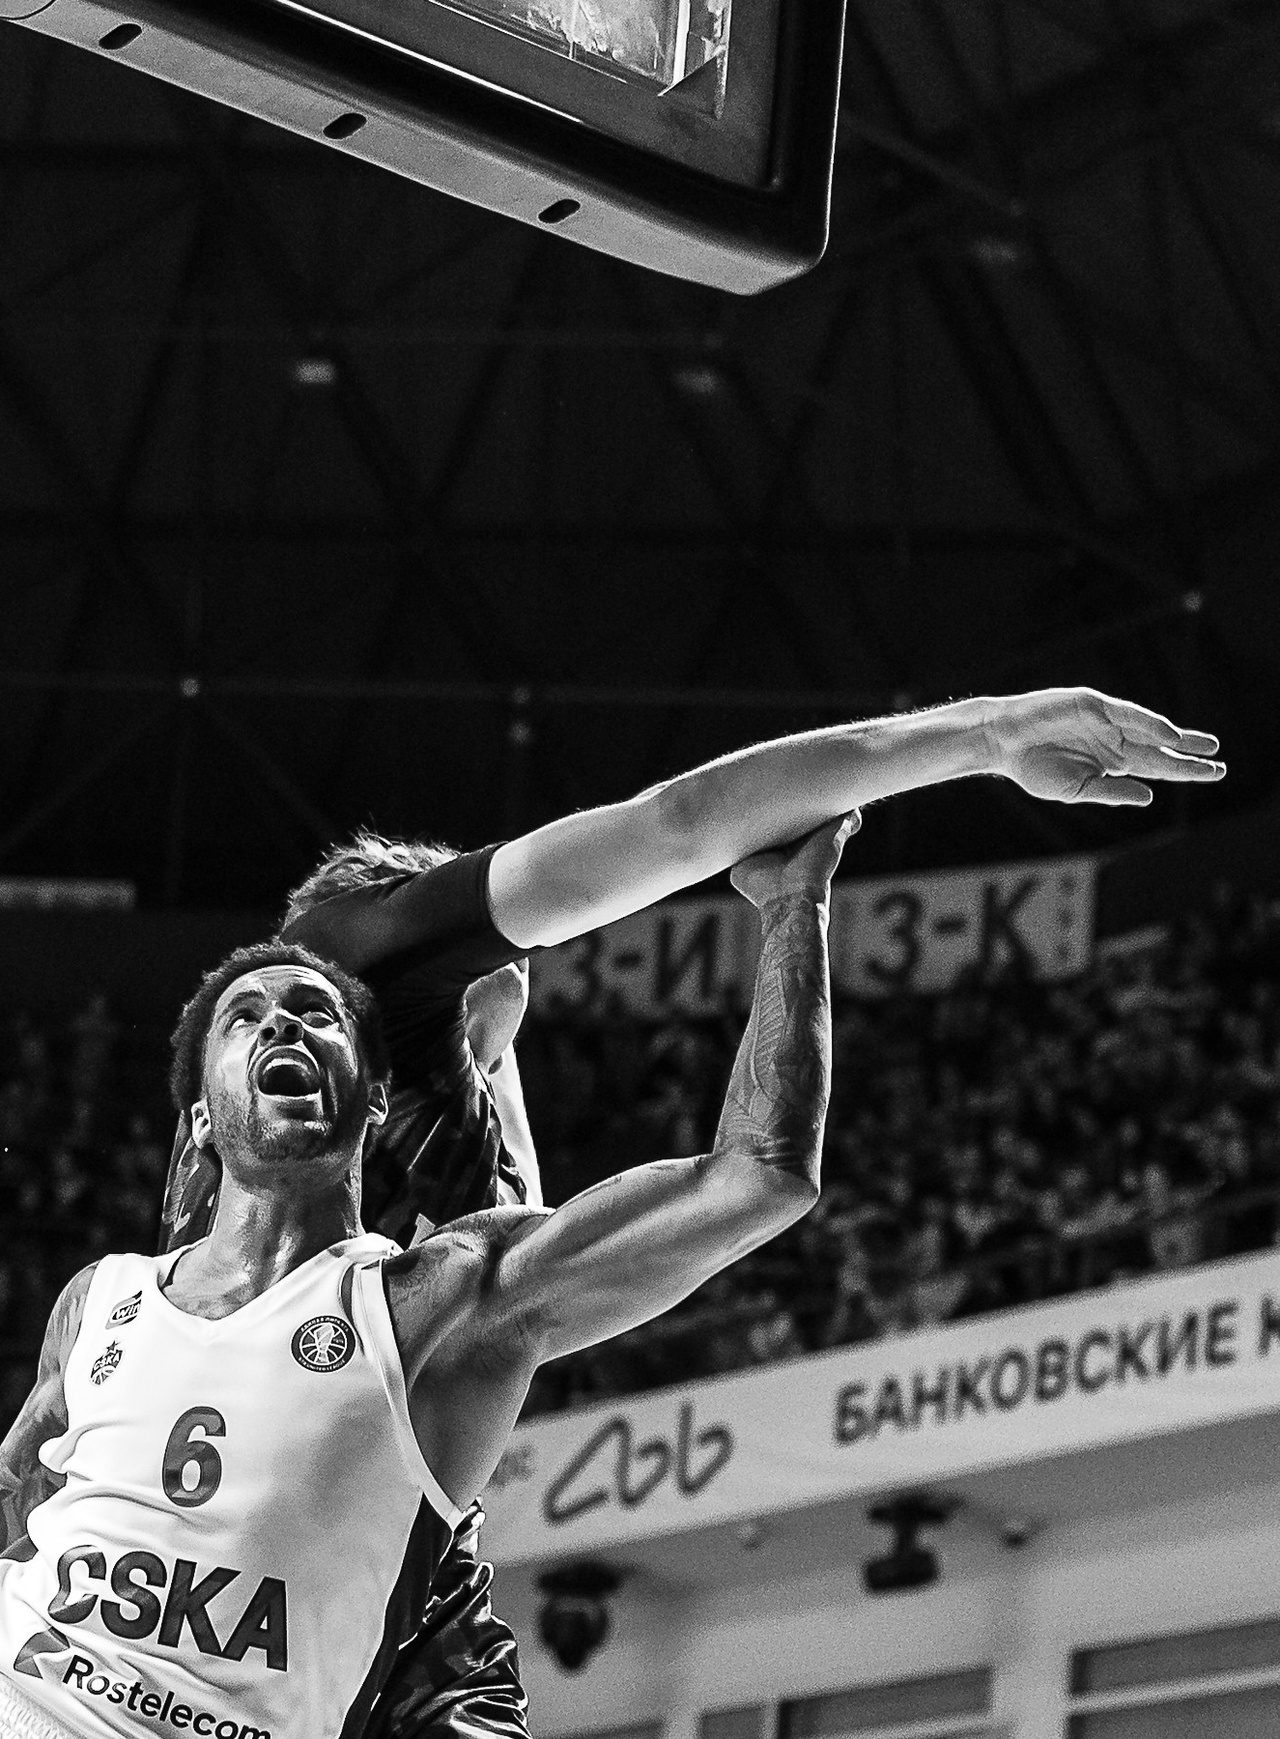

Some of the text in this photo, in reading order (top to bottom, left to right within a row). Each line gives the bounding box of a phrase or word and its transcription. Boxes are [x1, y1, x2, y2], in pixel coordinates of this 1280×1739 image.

[832, 1298, 1240, 1449] БАНКОВСКИЕ
[162, 1406, 227, 1508] 6
[48, 1544, 289, 1673] CSKA
